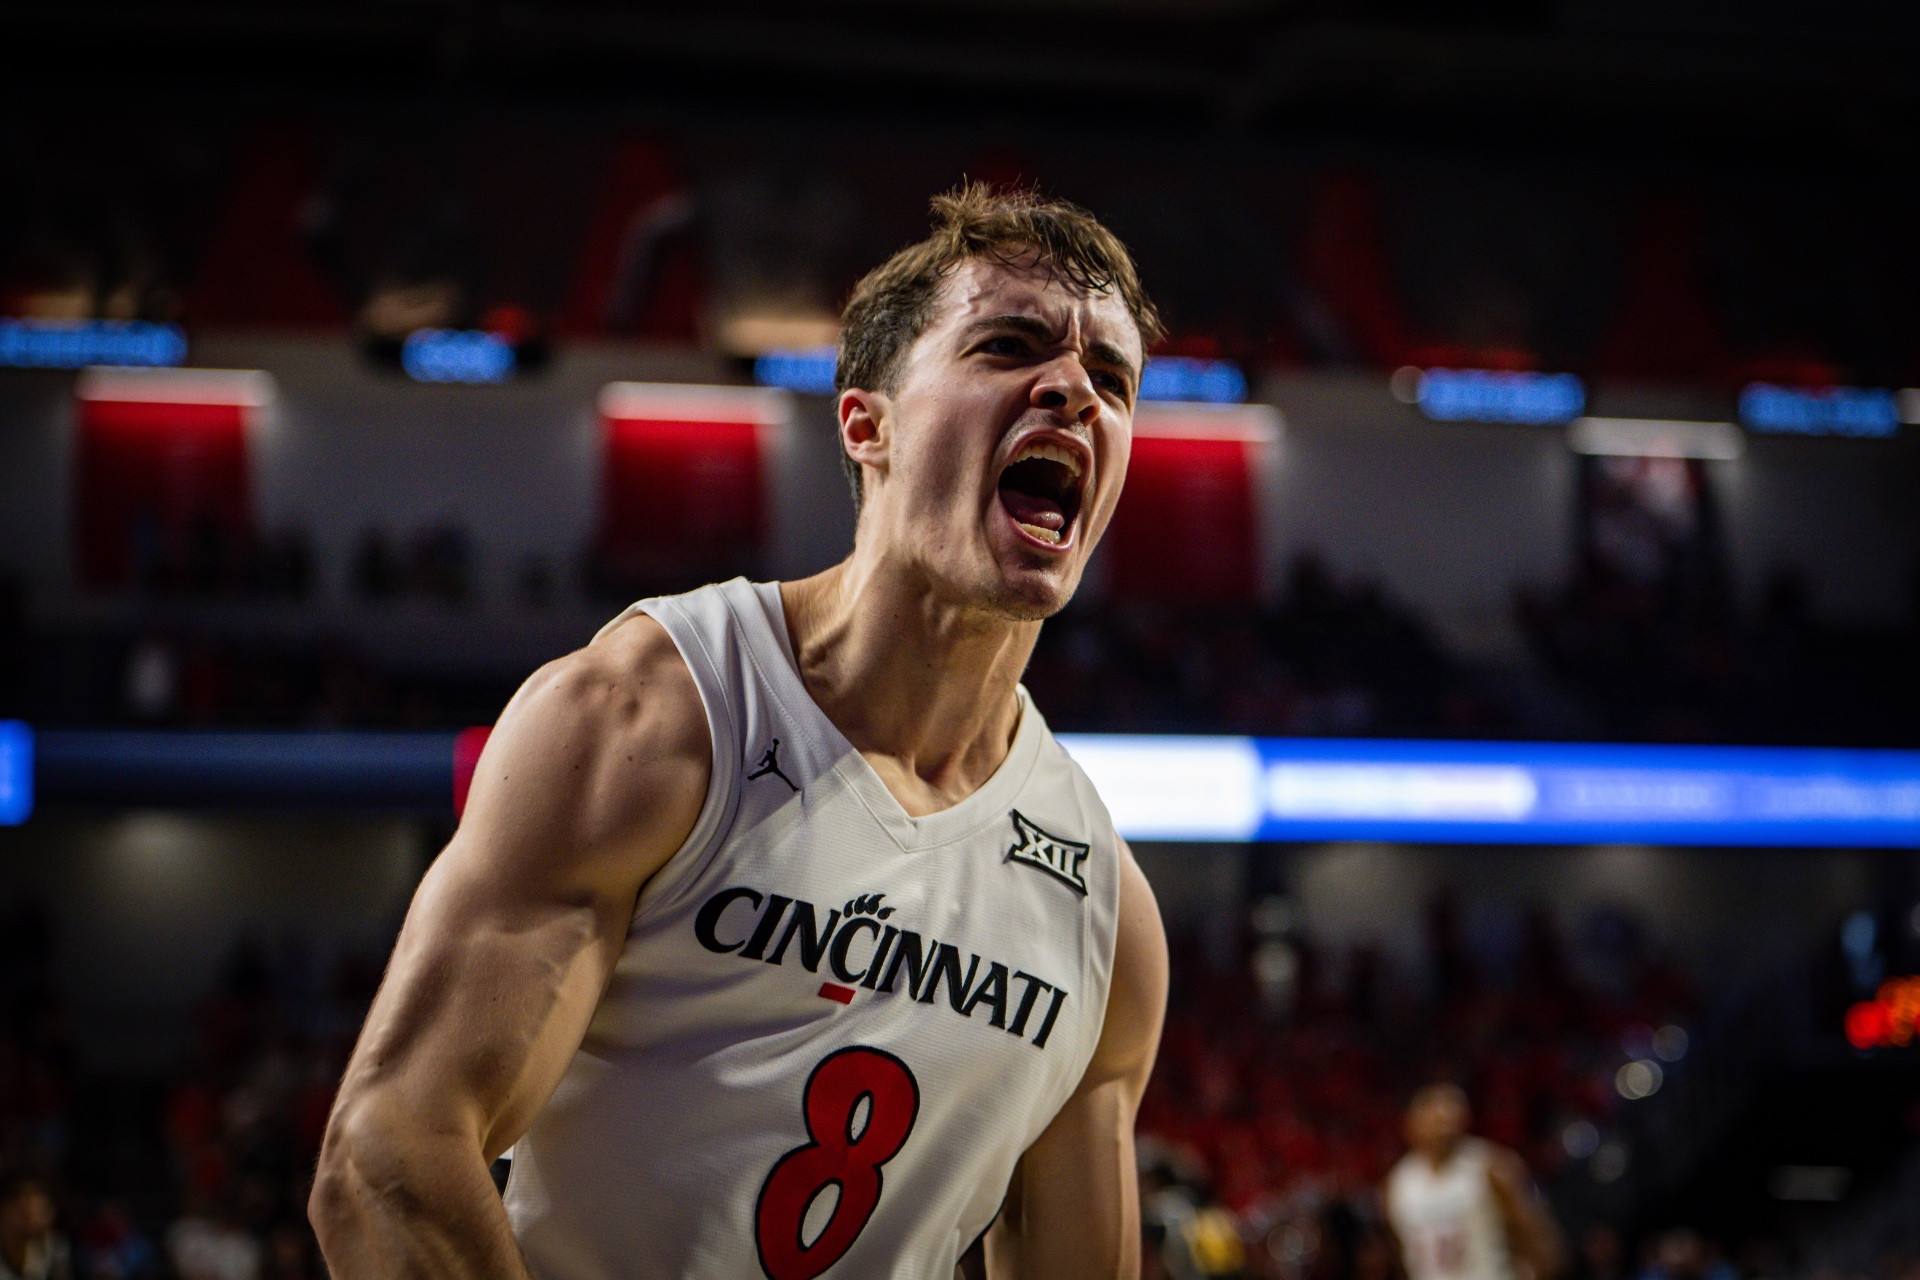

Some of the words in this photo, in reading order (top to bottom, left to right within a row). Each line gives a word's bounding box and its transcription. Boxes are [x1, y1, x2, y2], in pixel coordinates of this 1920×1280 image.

[1010, 810, 1089, 894] XII
[694, 887, 1068, 1048] CINCINNATI
[755, 1045, 920, 1280] 8
